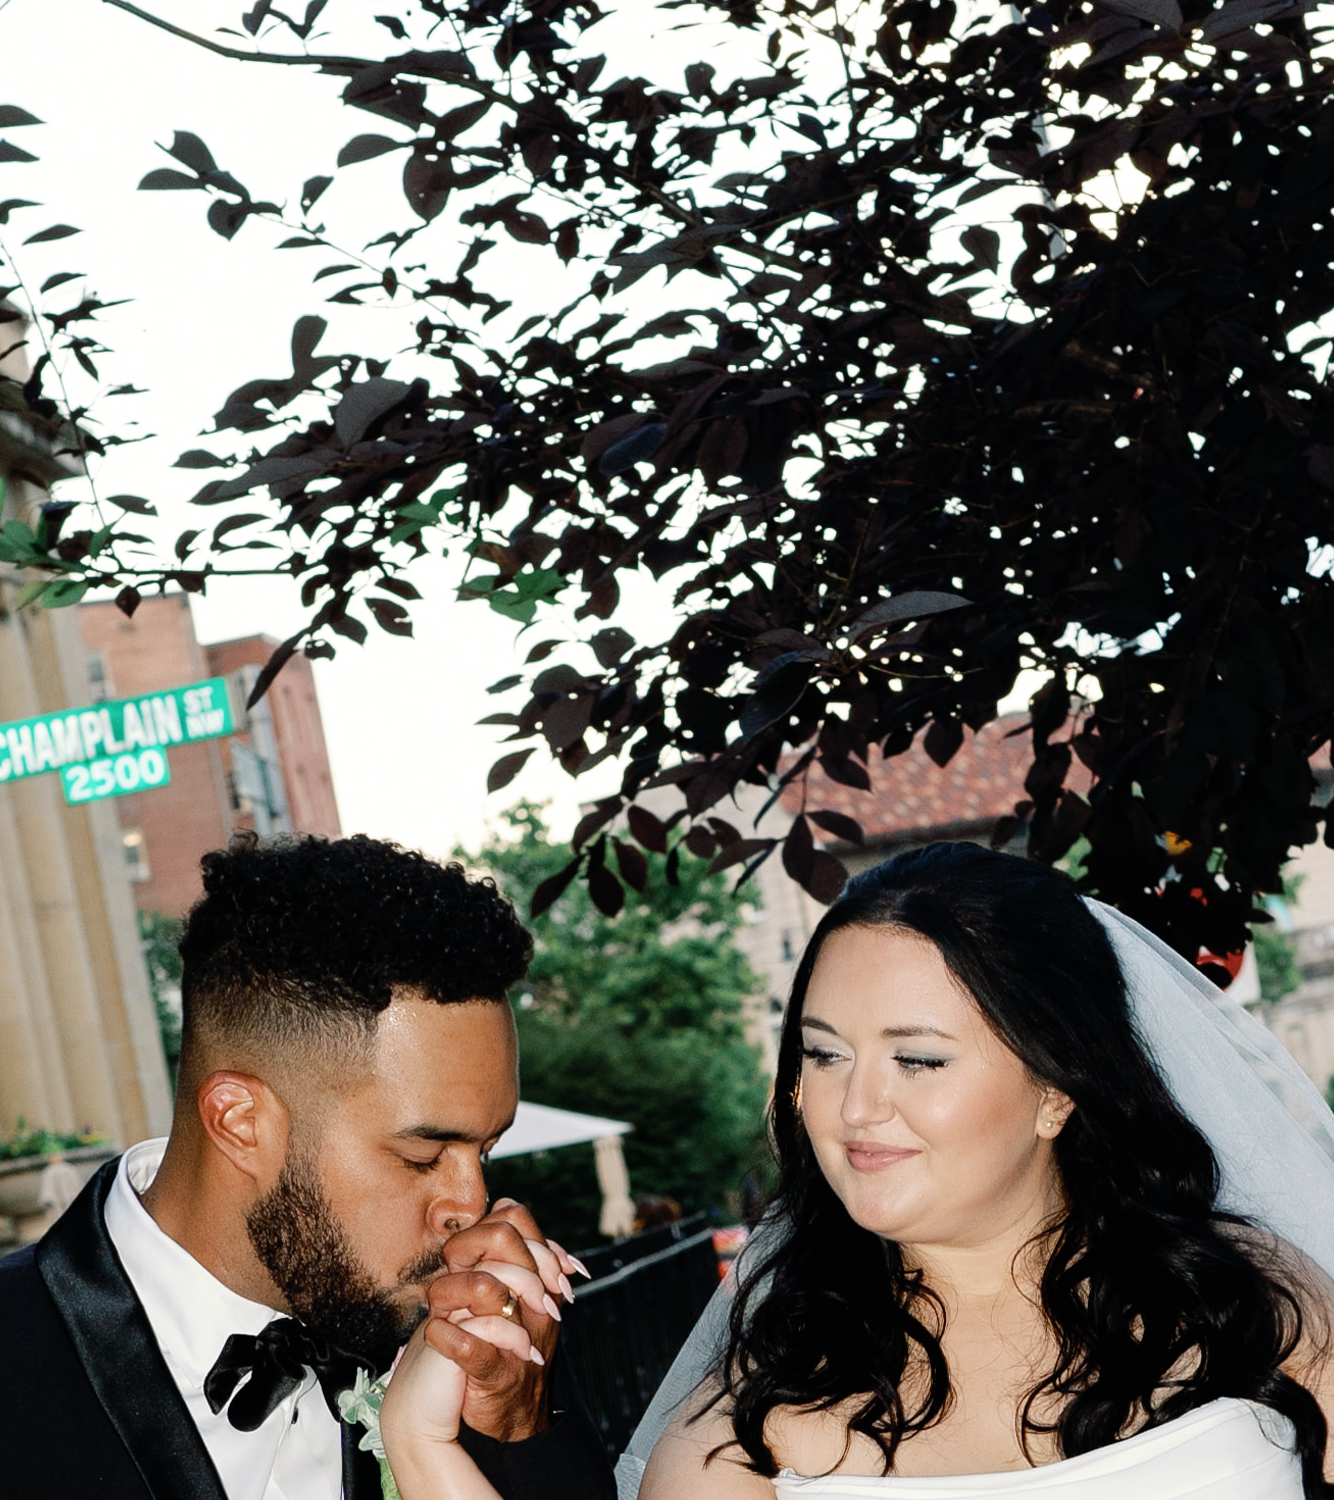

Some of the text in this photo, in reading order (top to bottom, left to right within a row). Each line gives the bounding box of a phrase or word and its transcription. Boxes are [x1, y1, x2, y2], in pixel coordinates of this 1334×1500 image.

[183, 687, 214, 714] ST
[185, 708, 225, 739] NW
[65, 749, 167, 802] 2500
